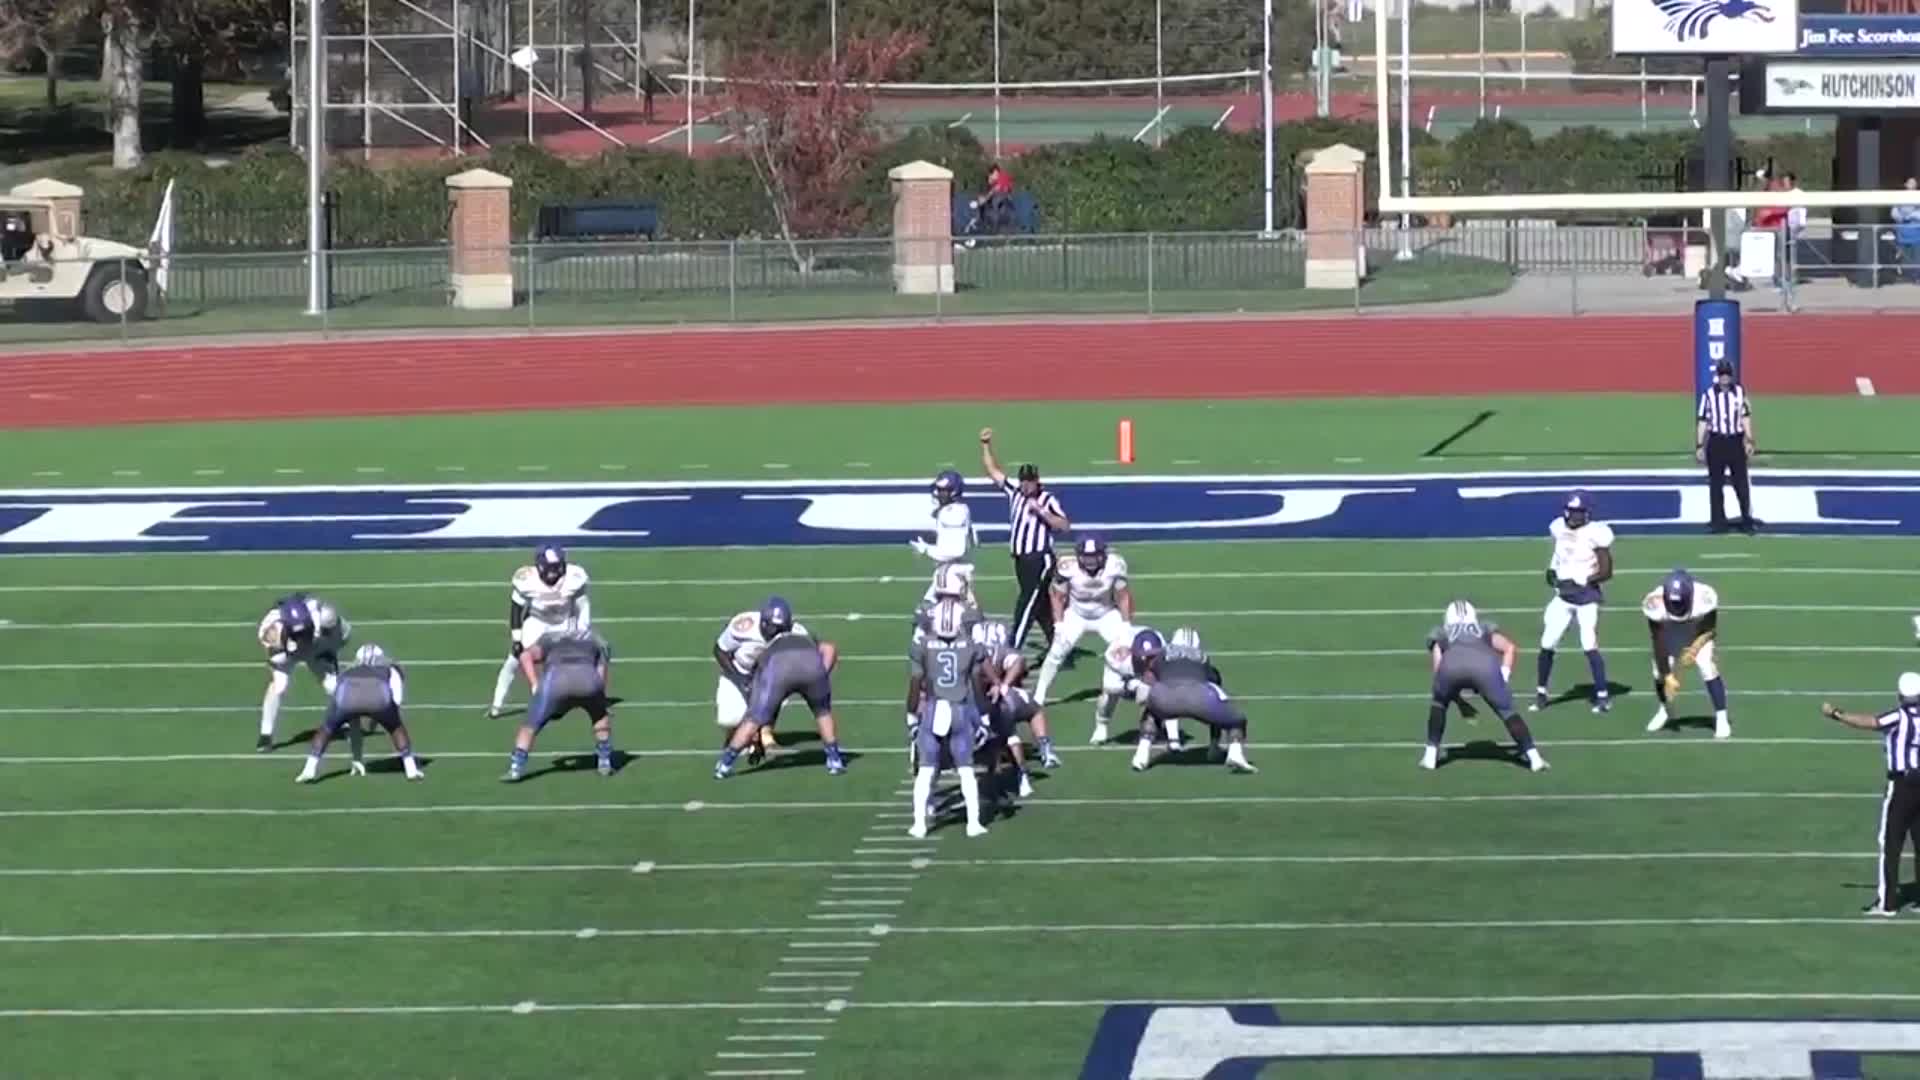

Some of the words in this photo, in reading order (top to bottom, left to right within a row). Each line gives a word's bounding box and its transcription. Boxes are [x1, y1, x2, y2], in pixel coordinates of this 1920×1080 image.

[1800, 28, 1826, 48] Jim
[1828, 28, 1855, 44] Fee
[1821, 73, 1916, 98] HUTCHINSON
[936, 651, 958, 687] 3
